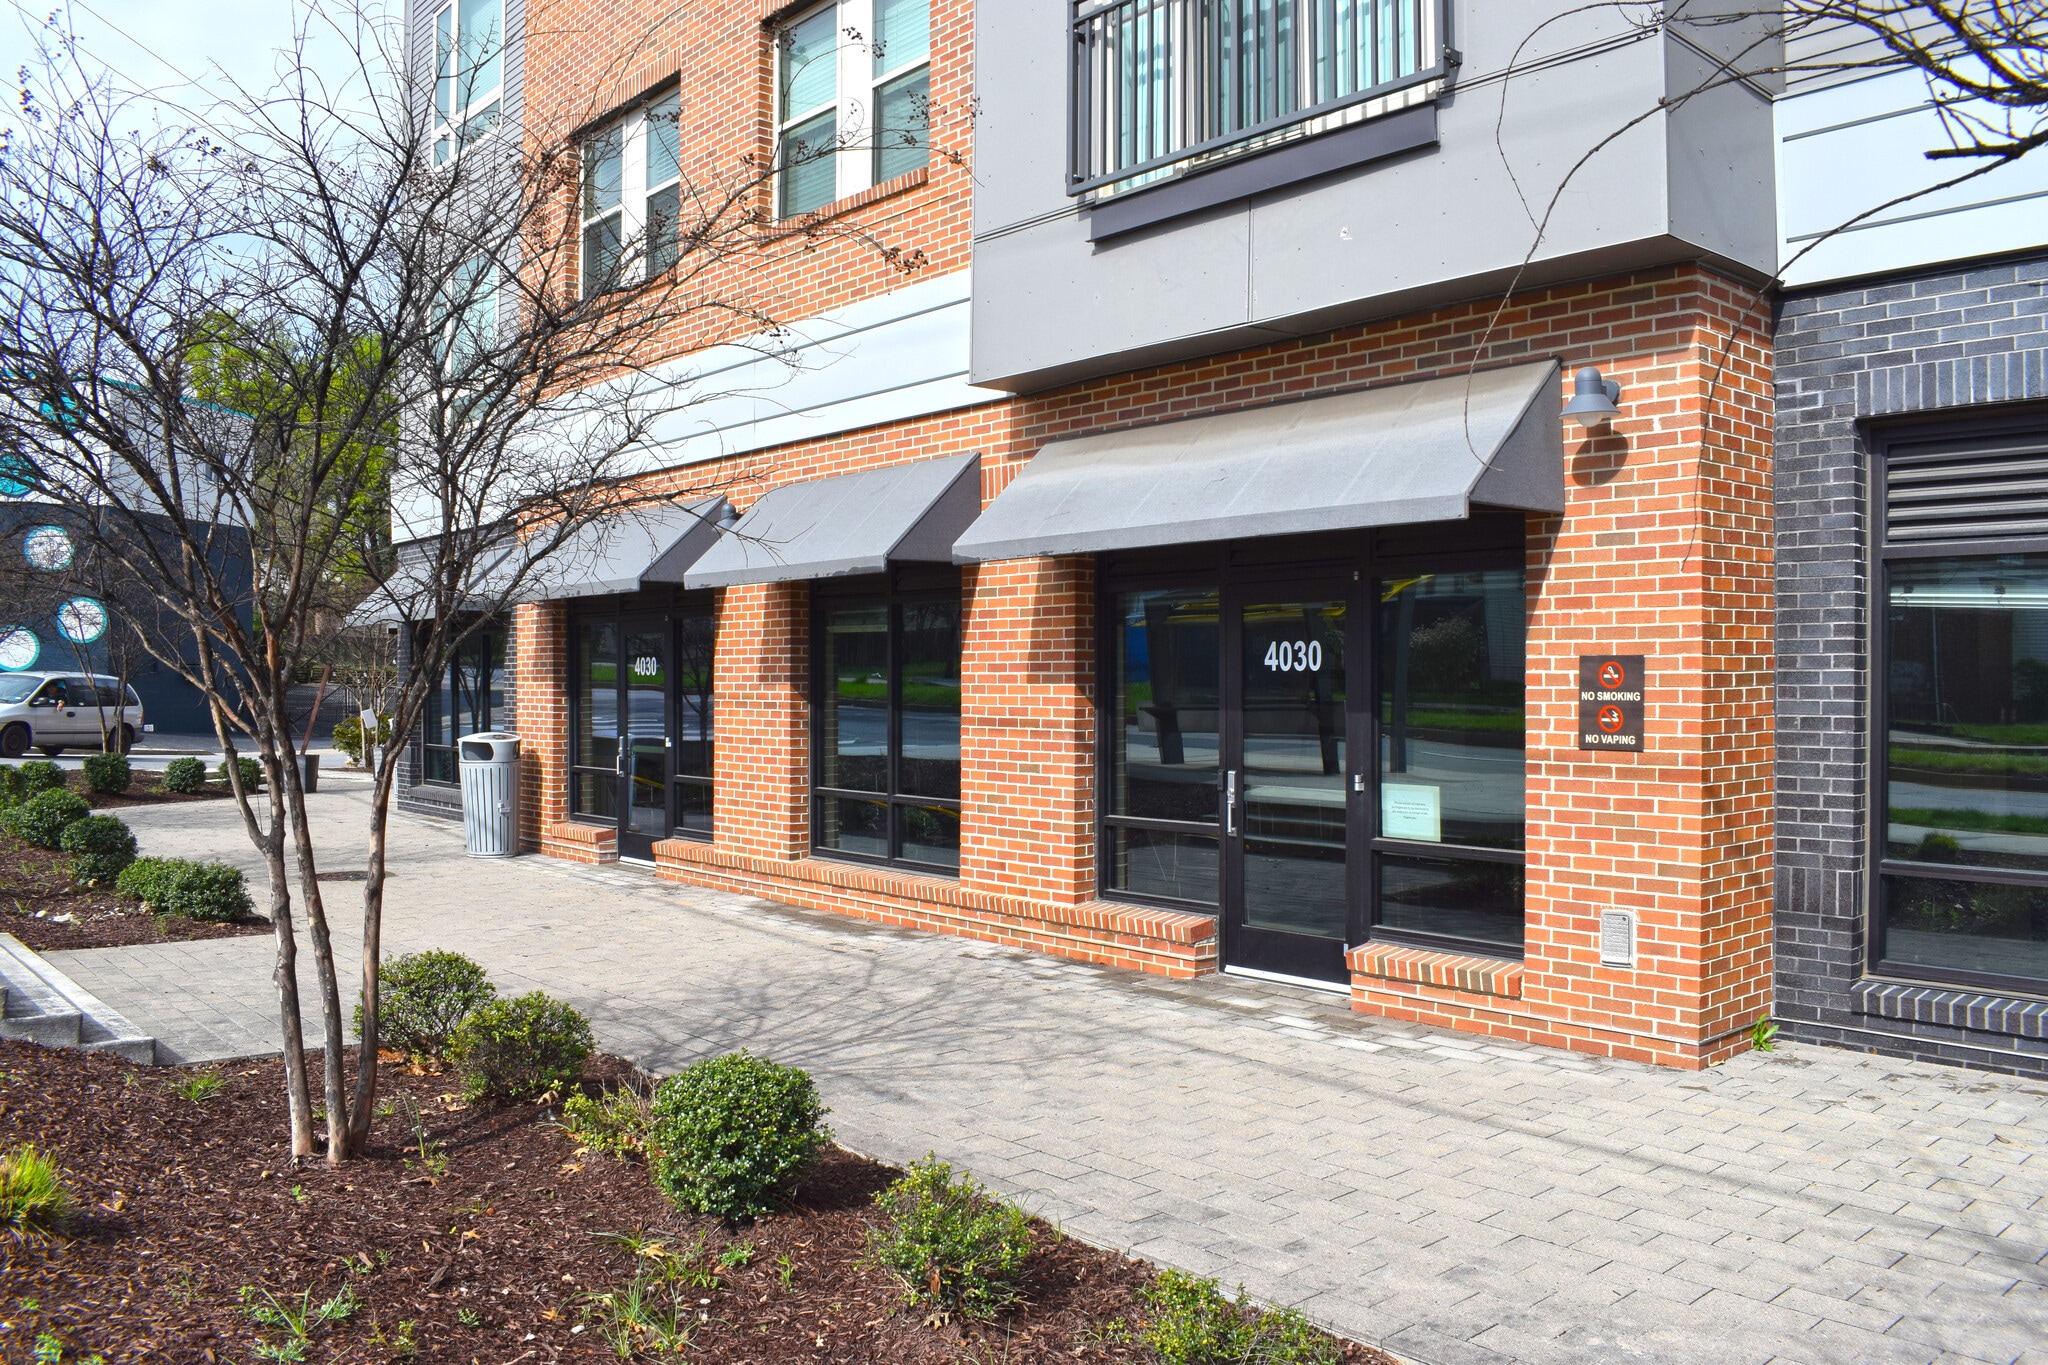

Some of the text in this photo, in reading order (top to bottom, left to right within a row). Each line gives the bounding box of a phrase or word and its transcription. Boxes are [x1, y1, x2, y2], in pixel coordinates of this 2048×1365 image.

[1263, 640, 1322, 672] 4030
[634, 656, 657, 676] 4030
[1581, 691, 1641, 702] NO SMOKING
[1585, 734, 1636, 745] NO VAPING
